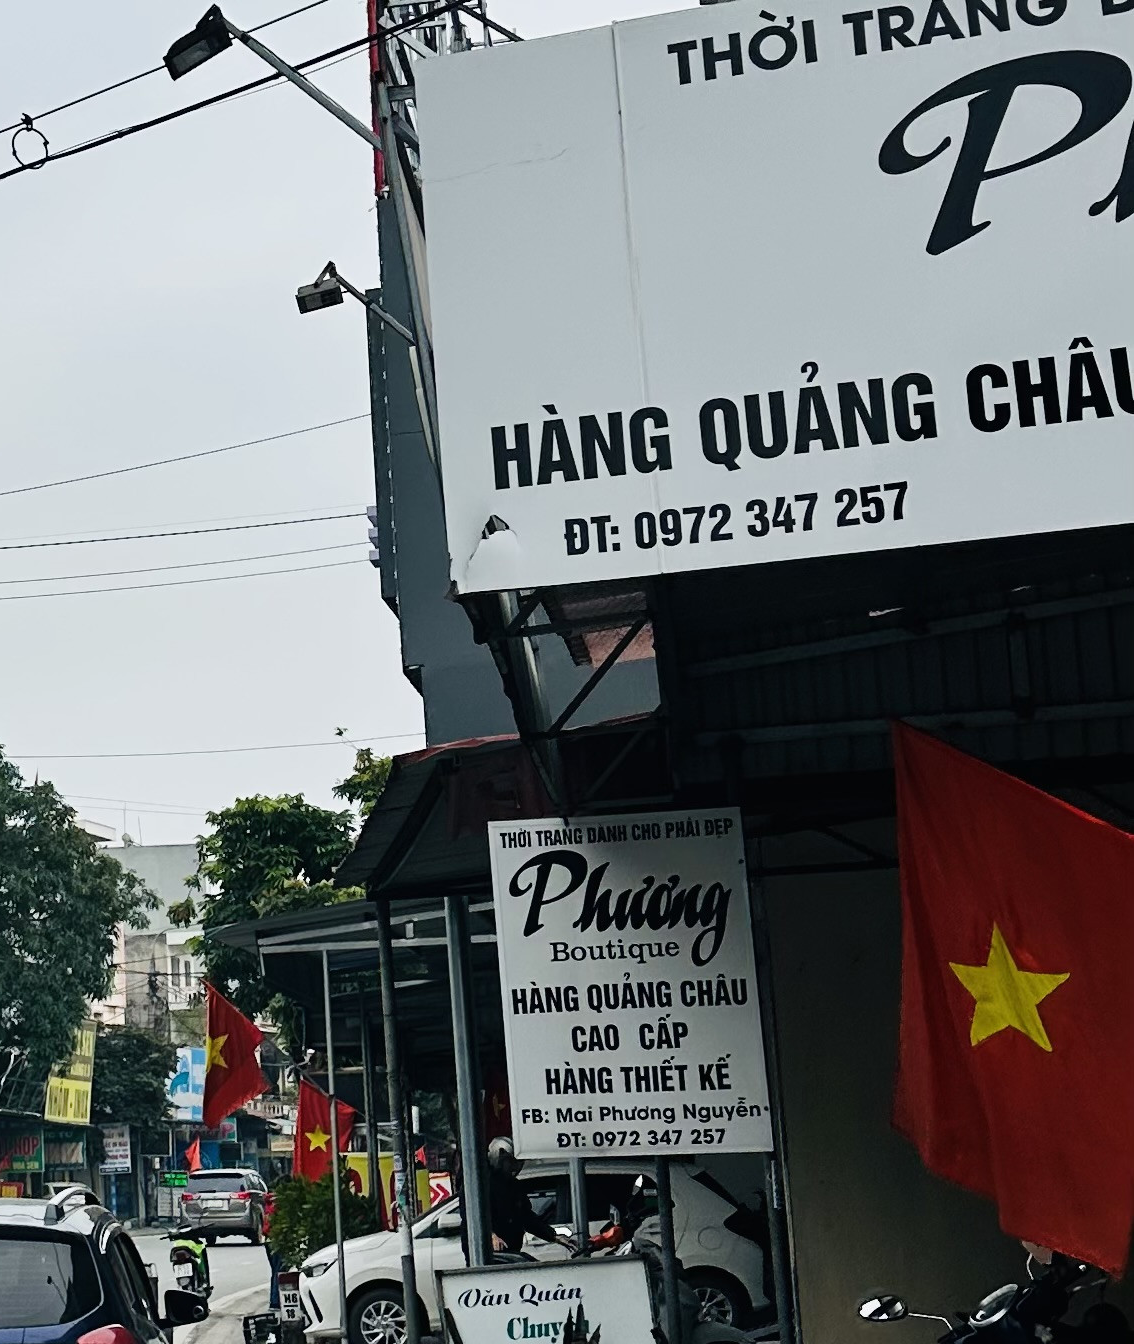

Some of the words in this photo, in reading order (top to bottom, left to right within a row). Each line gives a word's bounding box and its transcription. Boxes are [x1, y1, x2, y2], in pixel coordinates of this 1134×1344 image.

[667, 9, 819, 86] THỜI
[490, 403, 673, 491] HÀNG
[699, 361, 938, 472] QUẢNG
[564, 517, 621, 556] ĐT:
[634, 506, 734, 549] 0972
[746, 493, 818, 538] 347
[835, 481, 910, 528] 257
[500, 828, 532, 849] THỜI
[536, 826, 583, 847] TRANG
[587, 822, 627, 844] DÀNH
[632, 822, 661, 841] CHO
[704, 817, 733, 839] ĐẸP
[509, 849, 732, 967] Phương
[550, 939, 680, 963] Boutique
[512, 982, 579, 1015] HÀNG
[587, 972, 672, 1013] QUẢNG
[680, 974, 748, 1006] CHÂU
[571, 1024, 620, 1052] CAO
[639, 1013, 688, 1051] CẤP
[545, 1062, 613, 1095] HÀNG
[620, 1056, 688, 1093] THIẾT
[698, 1054, 732, 1091] KẾ
[521, 1109, 550, 1124] FB:
[556, 1106, 593, 1123] Mai
[600, 1104, 675, 1124] Phương
[683, 1097, 762, 1124] Nguyễn
[557, 1134, 587, 1148] ĐT:
[593, 1131, 641, 1147] 0972
[647, 1130, 683, 1146] 347
[690, 1129, 726, 1145] 257
[458, 1288, 511, 1308] Văn
[519, 1283, 583, 1305] Quân
[507, 1317, 590, 1343] Chuy
